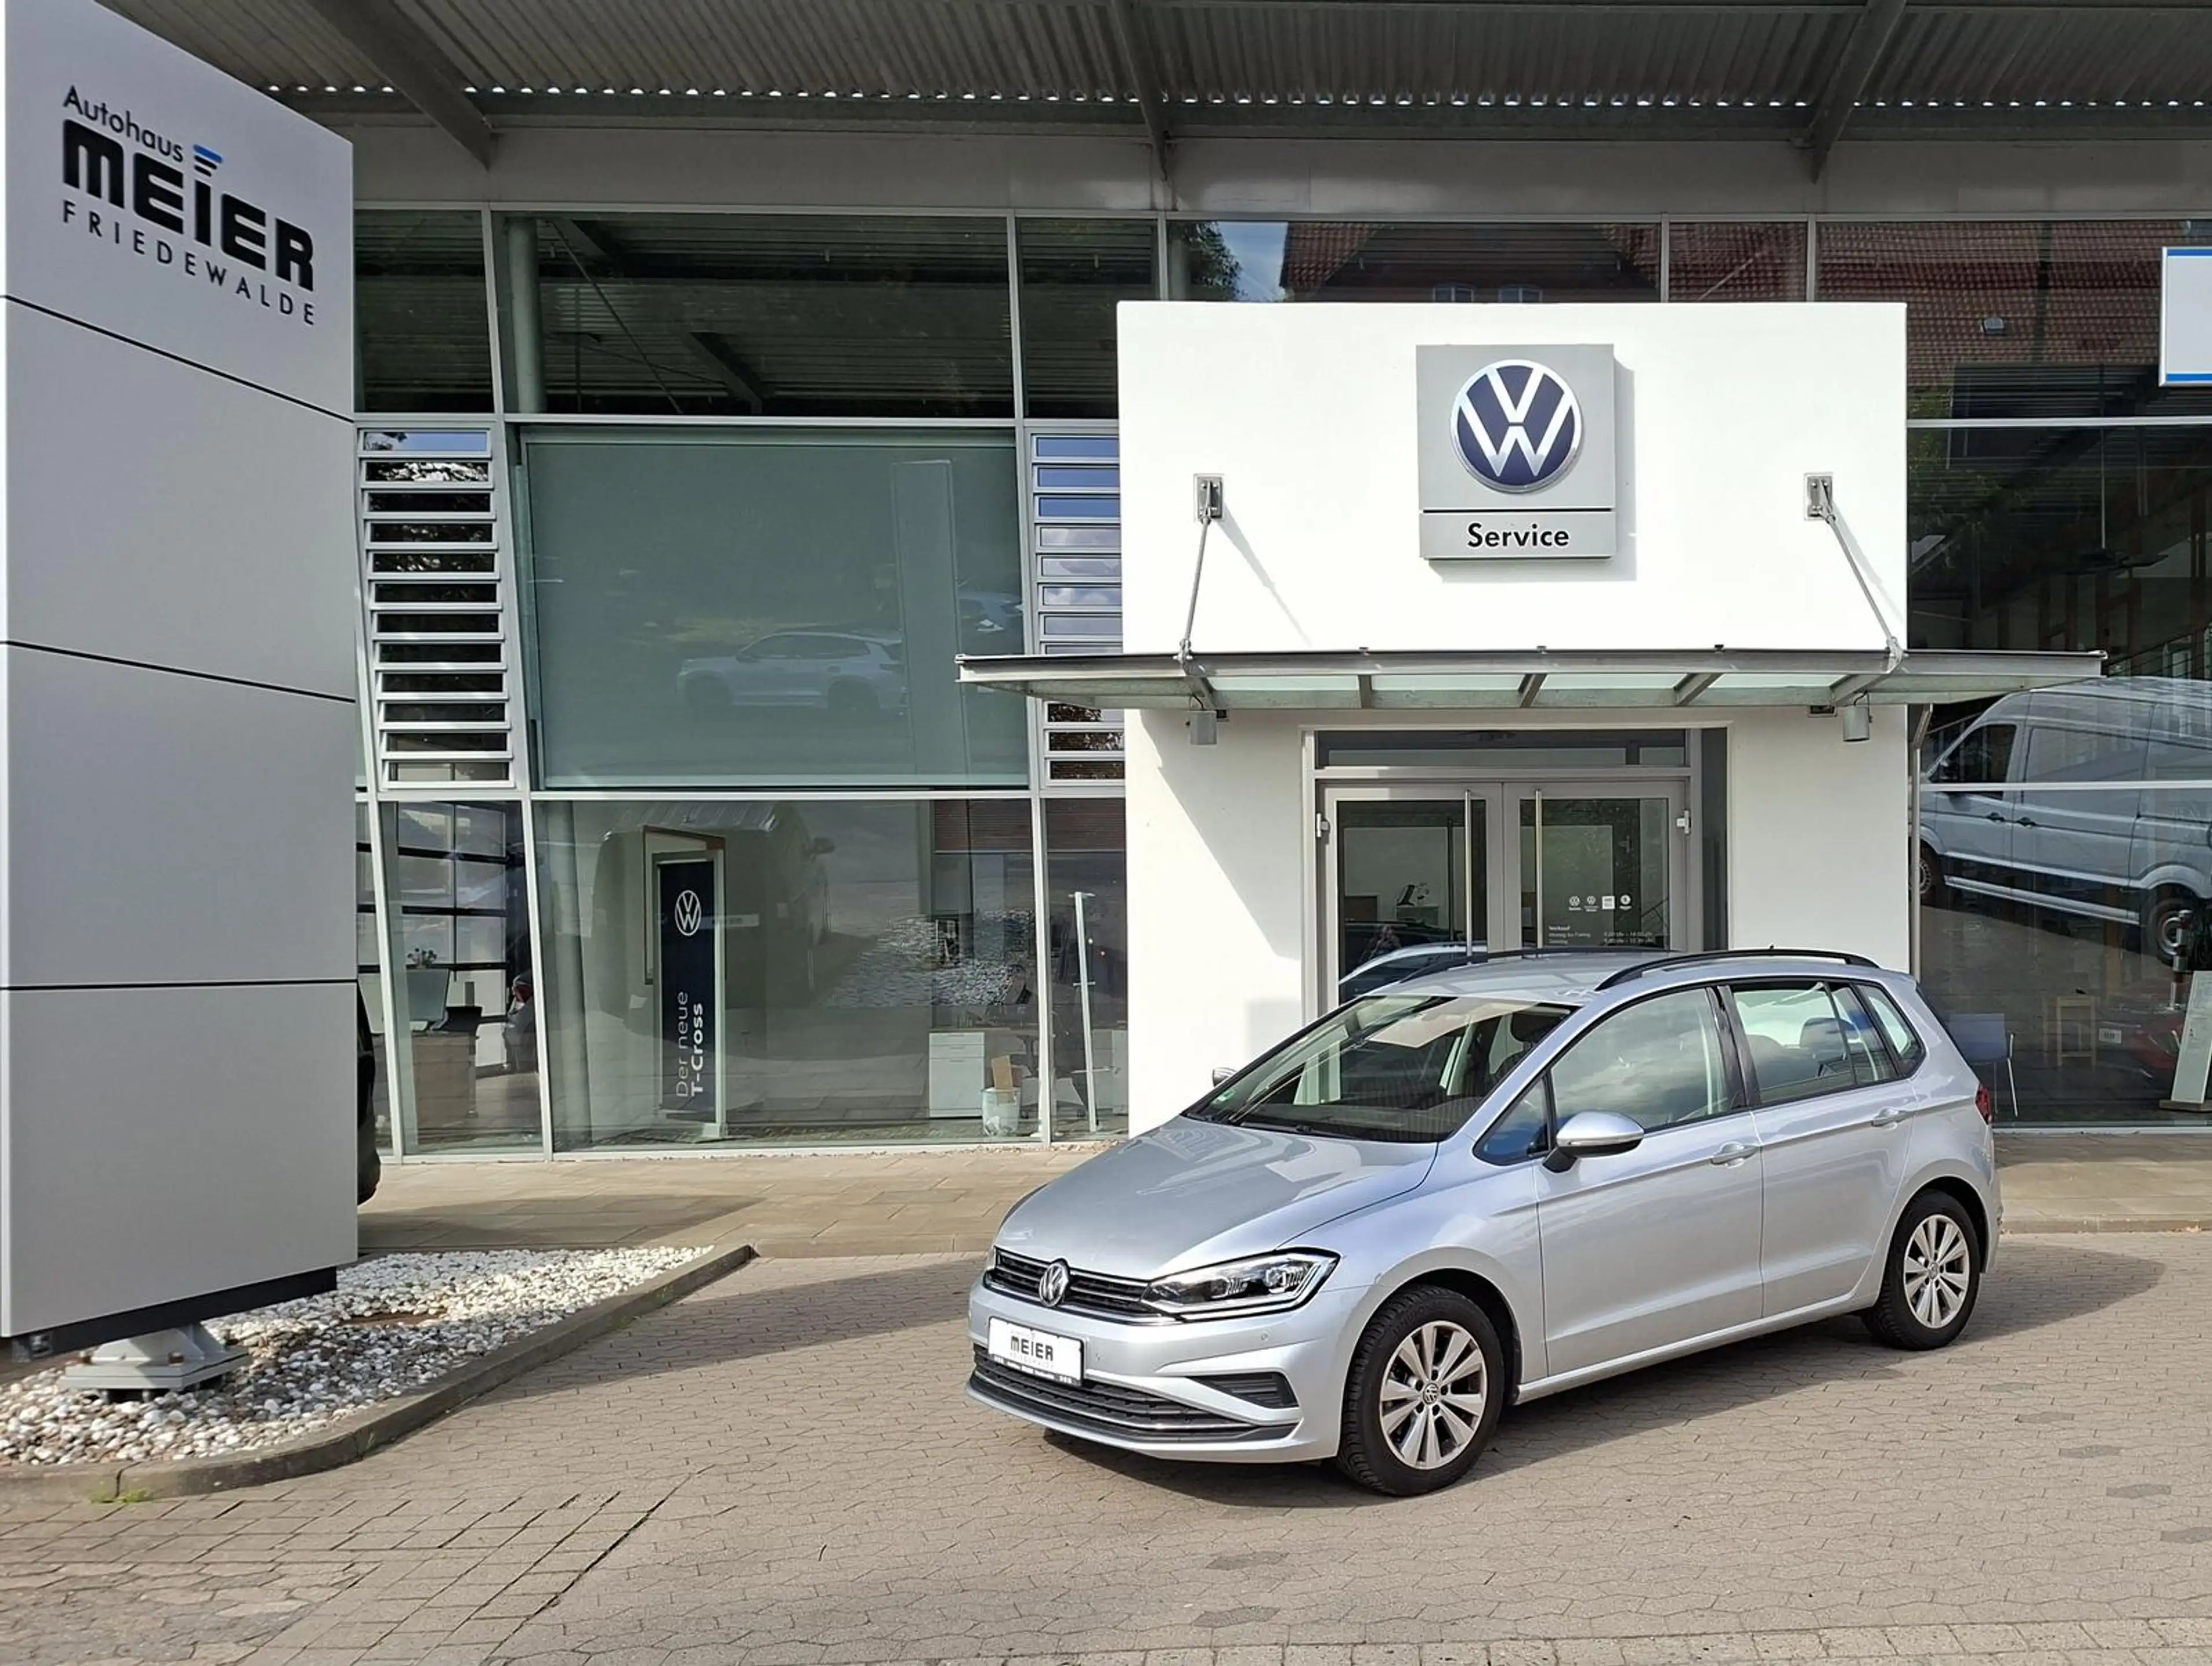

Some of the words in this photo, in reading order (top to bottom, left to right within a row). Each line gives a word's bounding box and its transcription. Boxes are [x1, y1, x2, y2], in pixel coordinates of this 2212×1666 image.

[62, 85, 183, 163] Autohaus
[62, 119, 314, 291] MEIER
[62, 200, 315, 326] FRIEDEWALDE
[1467, 522, 1569, 547] Service
[677, 992, 689, 1049] neue
[691, 1002, 703, 1096] T-Cross
[676, 1058, 689, 1097] Der
[1010, 1335, 1053, 1361] MEIER
